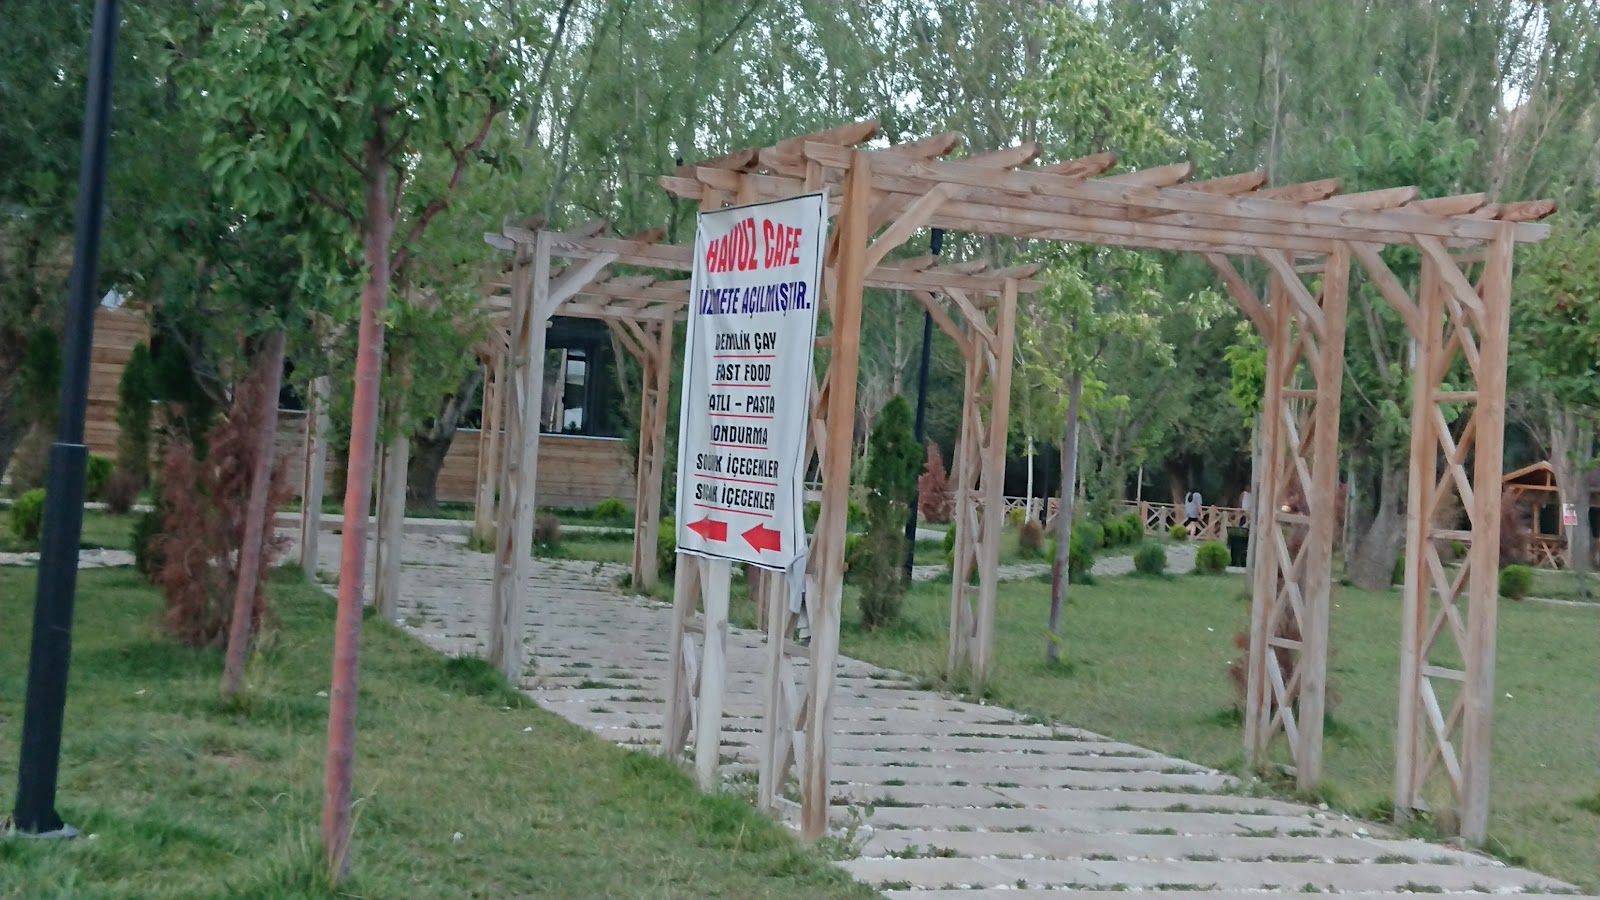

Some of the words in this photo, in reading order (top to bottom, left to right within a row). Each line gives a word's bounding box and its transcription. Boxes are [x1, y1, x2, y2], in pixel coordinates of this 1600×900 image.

[706, 217, 758, 273] HAVUZ
[763, 219, 802, 269] CAFE
[715, 330, 751, 350] DEMLİK
[754, 332, 776, 353] ÇAY
[716, 364, 741, 381] FAST
[744, 364, 771, 381] FOOD
[708, 394, 731, 411] ATLI
[746, 396, 775, 413] PASTA
[710, 425, 768, 445] ONDURMA
[726, 453, 779, 478] İÇECEKLER
[721, 484, 775, 510] İÇECEKLER
